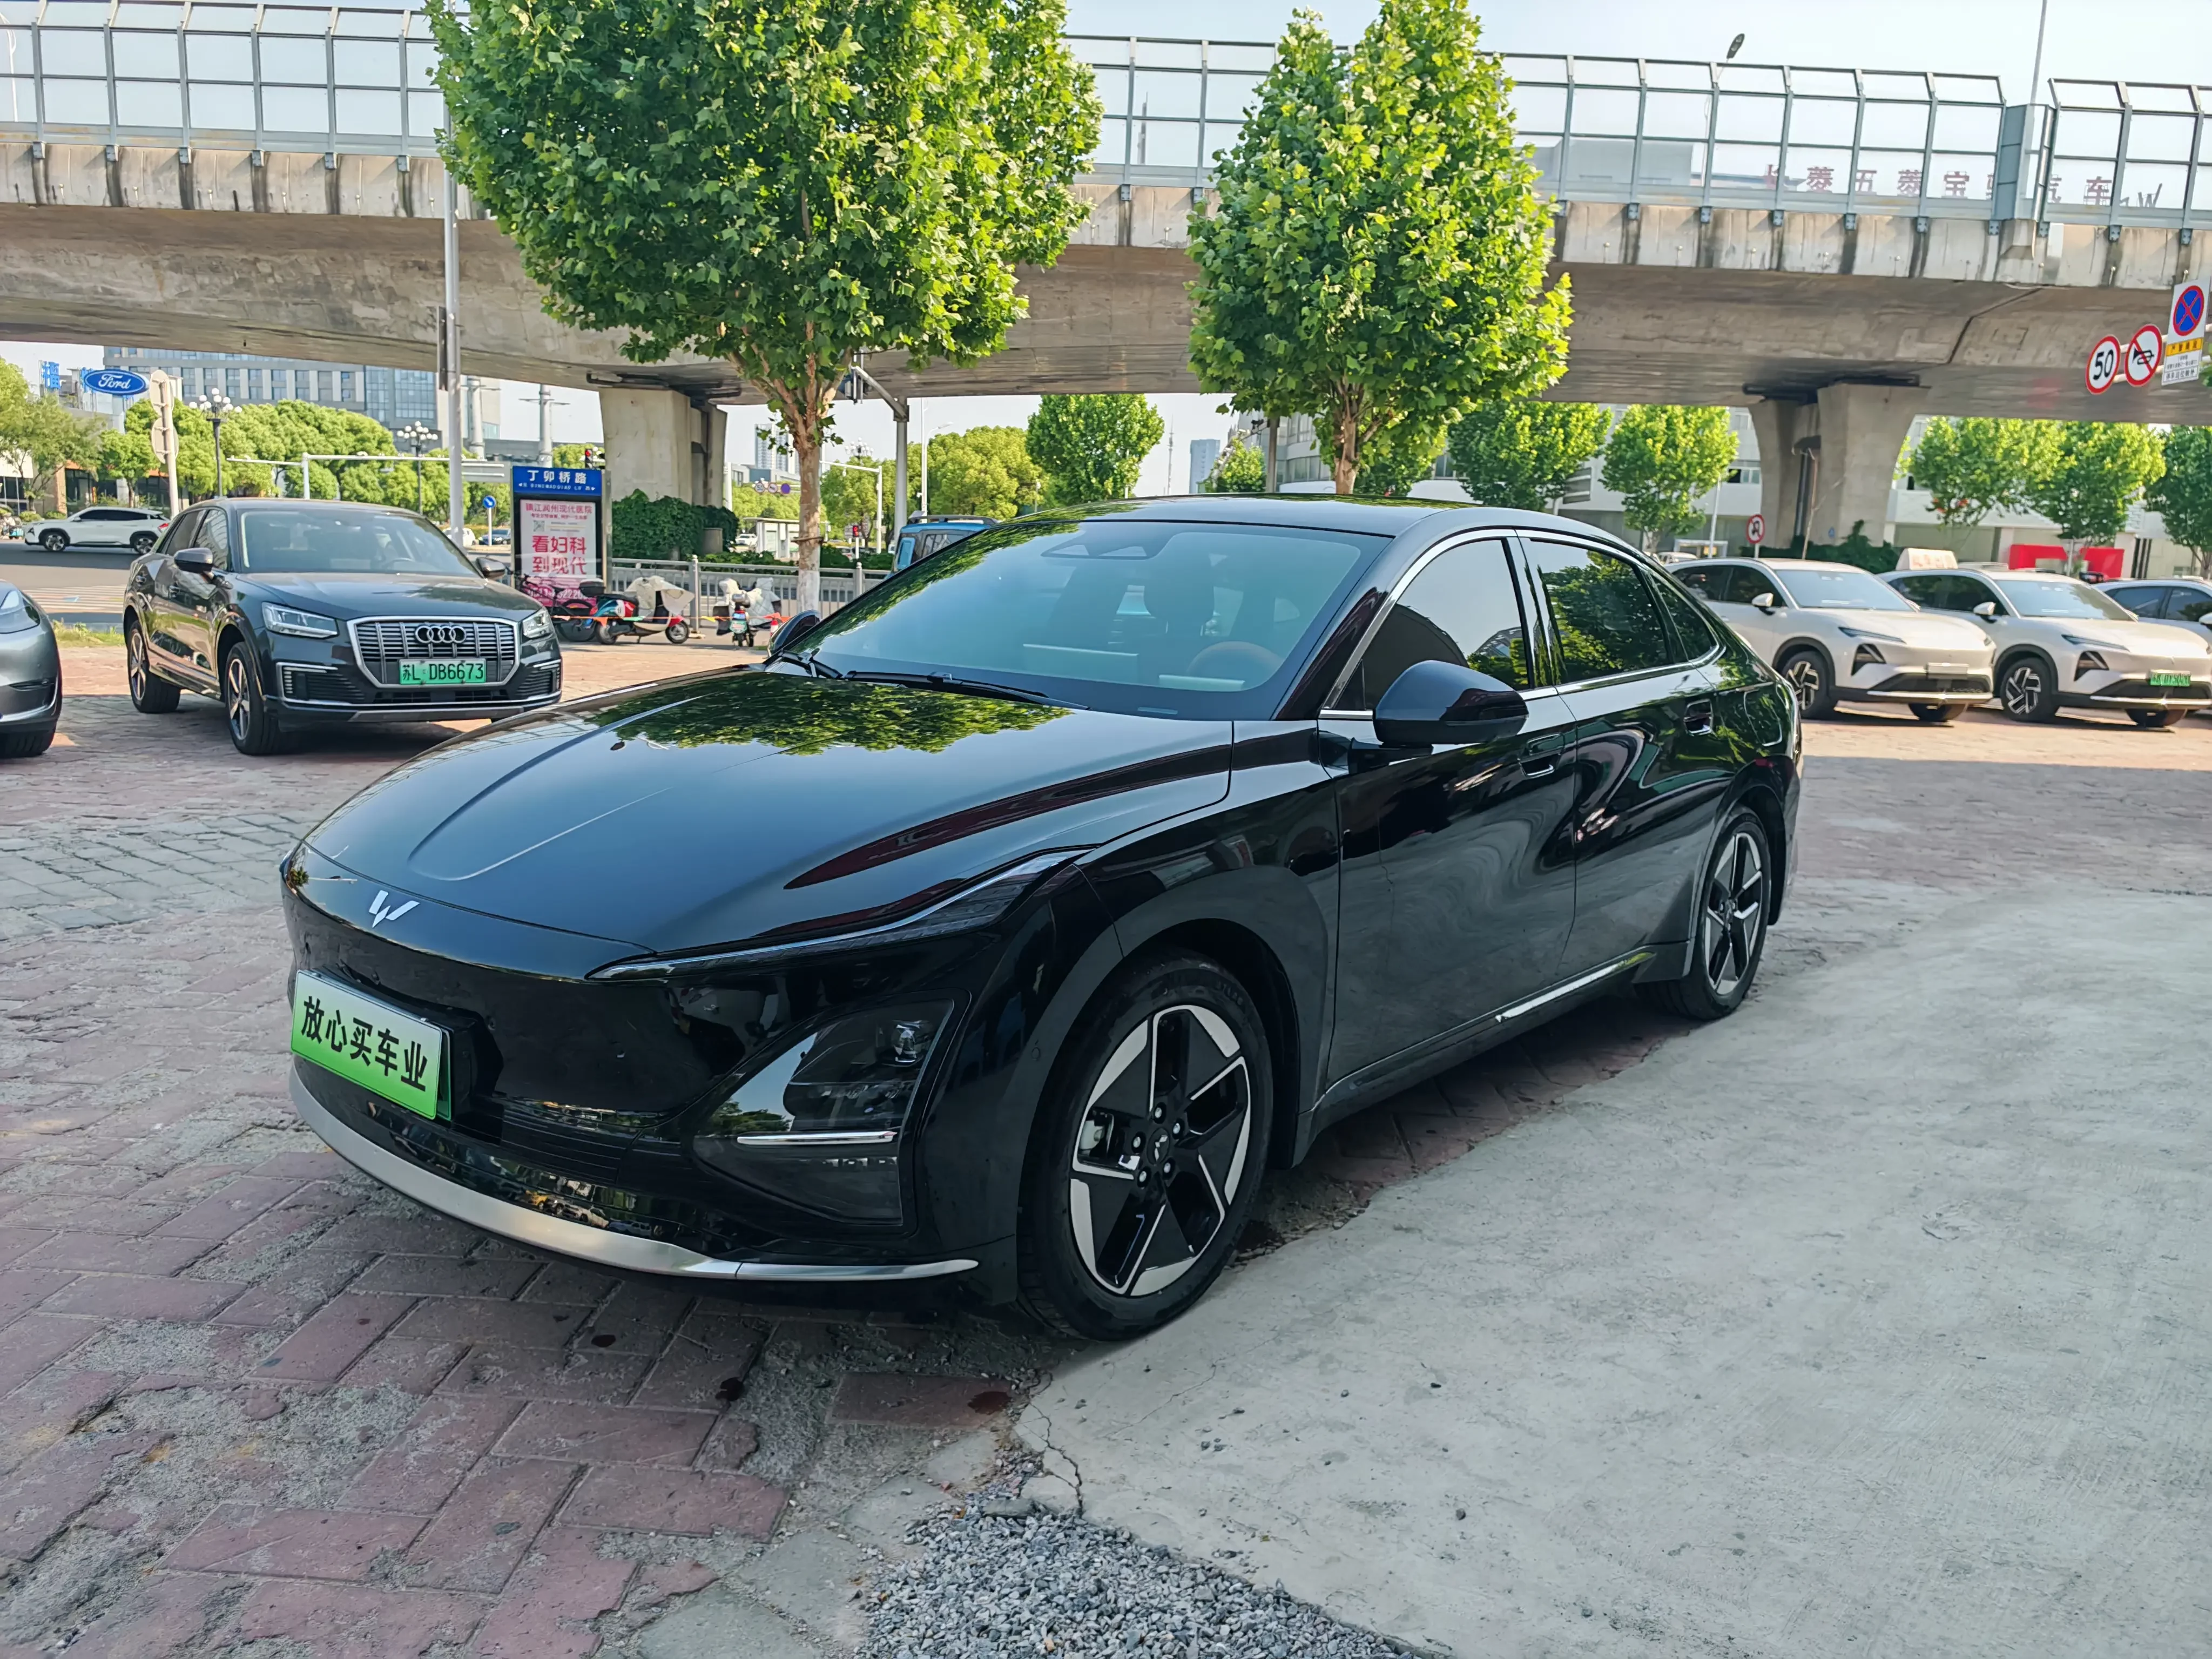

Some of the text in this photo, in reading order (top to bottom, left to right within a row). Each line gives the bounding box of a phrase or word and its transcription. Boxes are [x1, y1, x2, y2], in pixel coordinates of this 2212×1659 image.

[1764, 164, 2112, 206] 菱五菱宝车
[2093, 349, 2114, 380] 50
[98, 373, 131, 390] Ford
[527, 470, 586, 484] 丁卯桥路
[532, 535, 587, 555] 看妇科
[532, 556, 587, 575] 到现代
[301, 996, 428, 1092] 放心买车业
